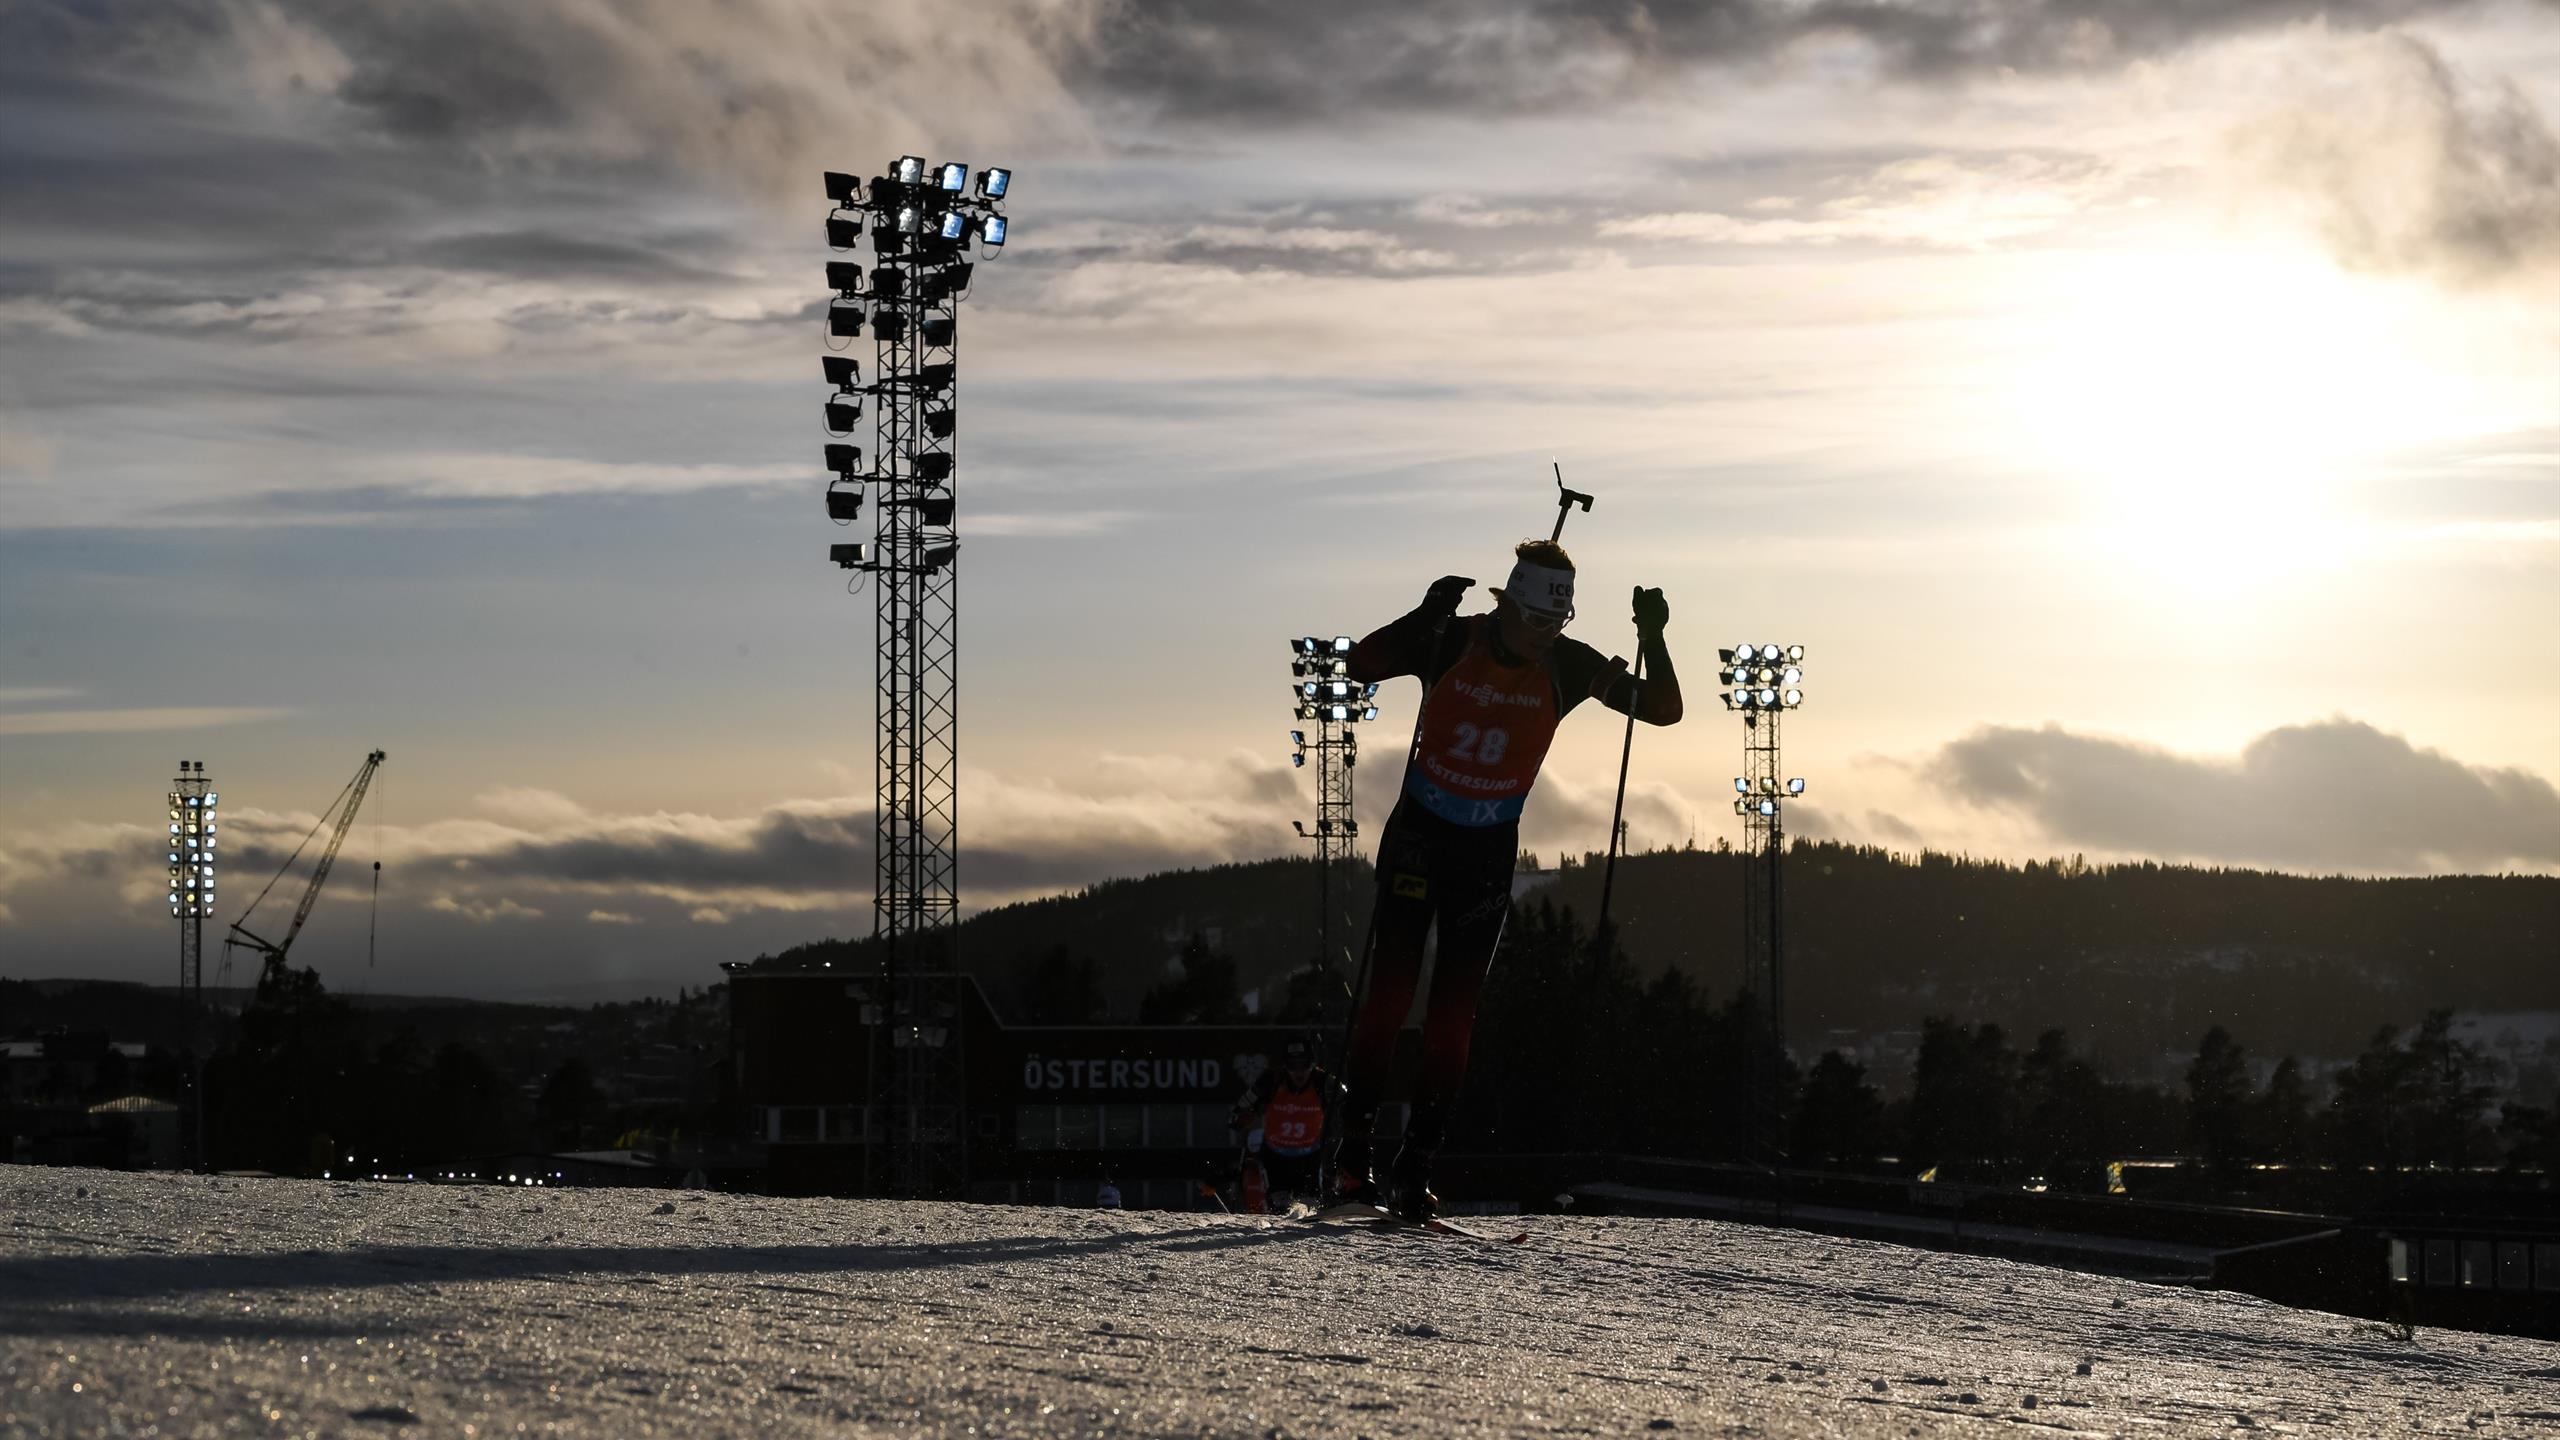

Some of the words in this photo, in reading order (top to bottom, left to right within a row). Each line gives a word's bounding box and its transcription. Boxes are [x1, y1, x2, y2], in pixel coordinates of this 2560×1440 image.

[1455, 679, 1542, 708] VIESSMANN
[1447, 721, 1510, 766] 28
[1426, 755, 1518, 791] ÖSTERSUND
[1471, 801, 1502, 823] iX
[1024, 1054, 1220, 1089] ÖSTERSUND
